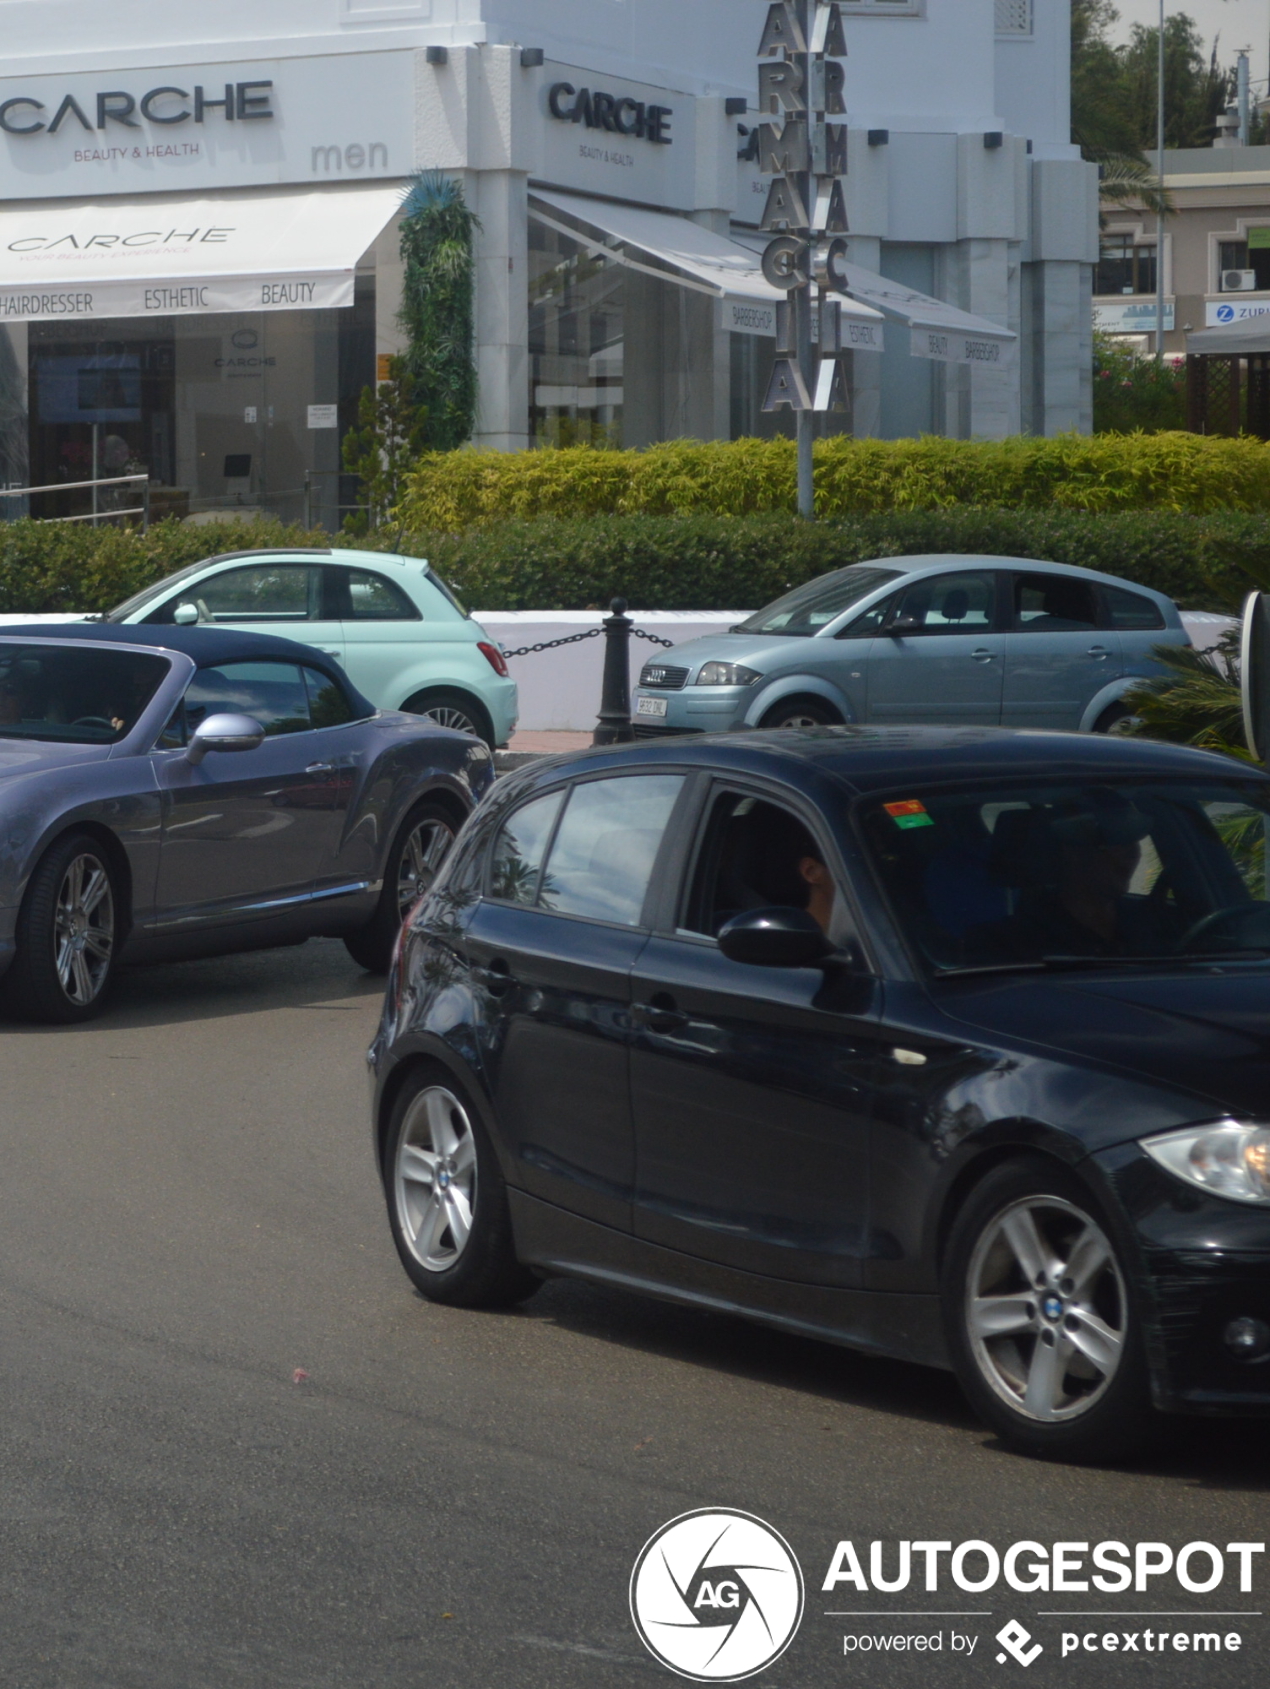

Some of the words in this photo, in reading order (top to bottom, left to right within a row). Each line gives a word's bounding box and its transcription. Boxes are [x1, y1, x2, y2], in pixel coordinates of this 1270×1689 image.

[548, 82, 673, 145] CARCHE
[74, 147, 128, 162] BEAUTY
[131, 146, 141, 159] &
[146, 143, 200, 157] HEALTH
[310, 140, 389, 173] men
[579, 145, 604, 159] BEAUTY
[610, 152, 634, 167] HEALTH
[7, 227, 236, 251] CARCHE
[19, 252, 54, 262] YOUR
[56, 251, 107, 261] BEAUTY
[111, 246, 193, 259] EXPERIENCE
[144, 286, 209, 309] ESTHETIC
[261, 282, 316, 304] BEAUTY
[733, 306, 772, 330] BARBERSHOP
[849, 324, 876, 345] ESTHETIC
[214, 357, 276, 367] CARCHE
